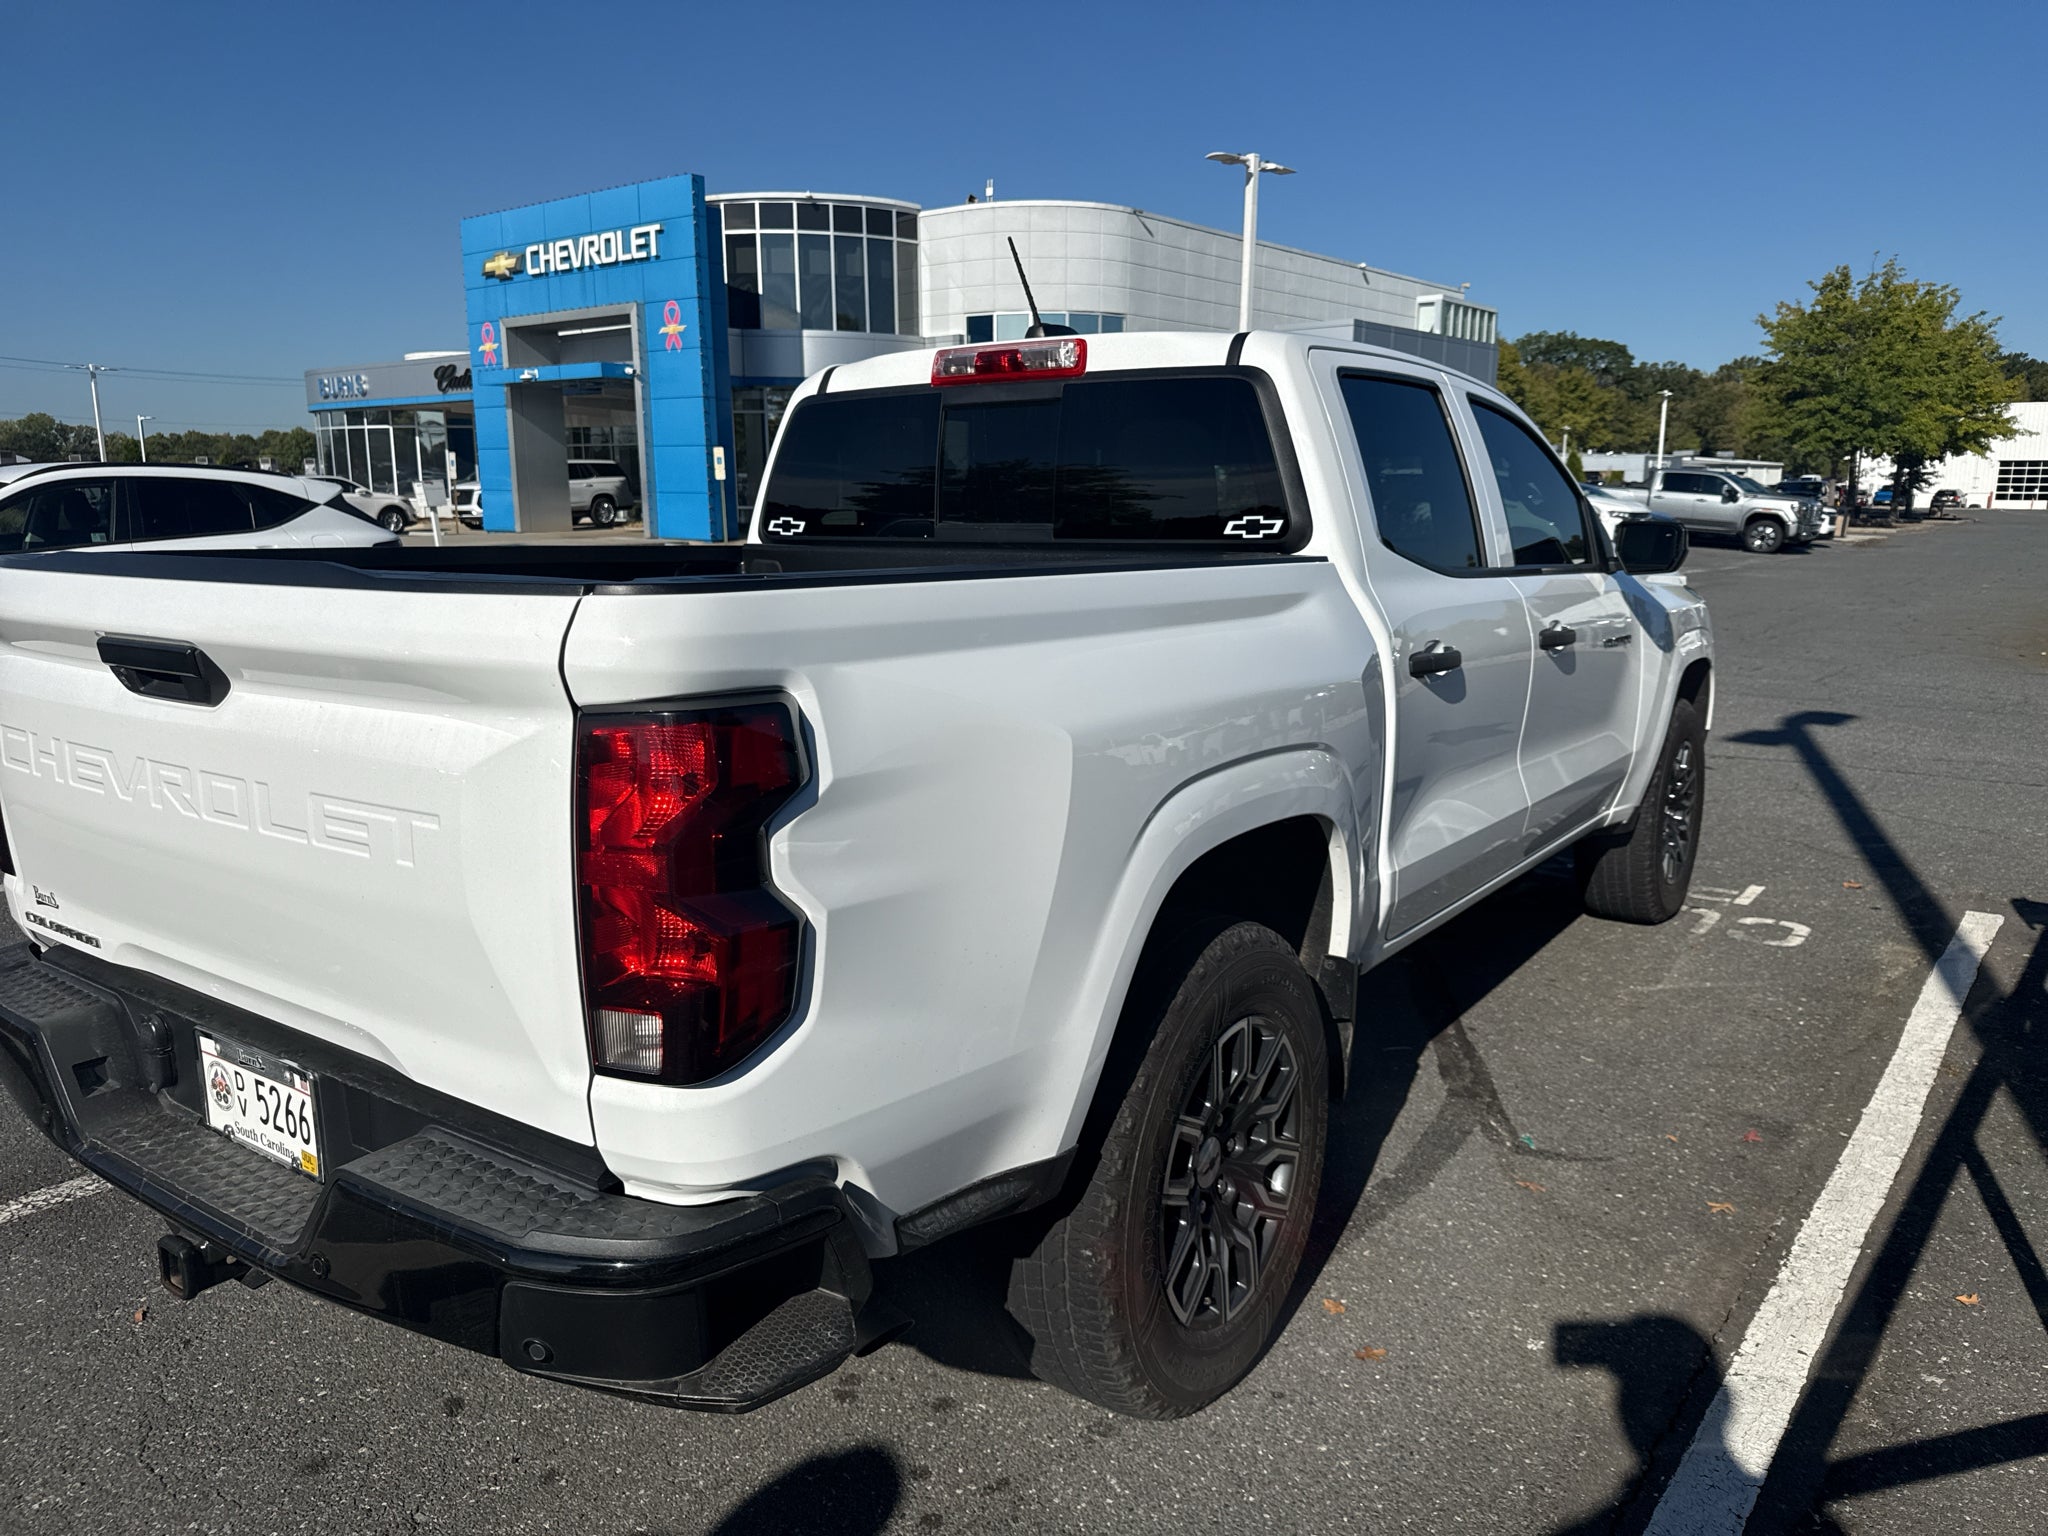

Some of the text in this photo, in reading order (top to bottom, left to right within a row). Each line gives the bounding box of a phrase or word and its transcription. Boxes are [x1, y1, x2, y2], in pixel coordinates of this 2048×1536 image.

[525, 223, 662, 276] CHEVROLET
[318, 374, 369, 399] BURNS
[0, 724, 440, 868] CHEVROLET
[234, 1070, 245, 1092] D
[237, 1095, 247, 1117] V
[254, 1078, 311, 1145] 5266
[234, 1121, 295, 1159] South Carolina
